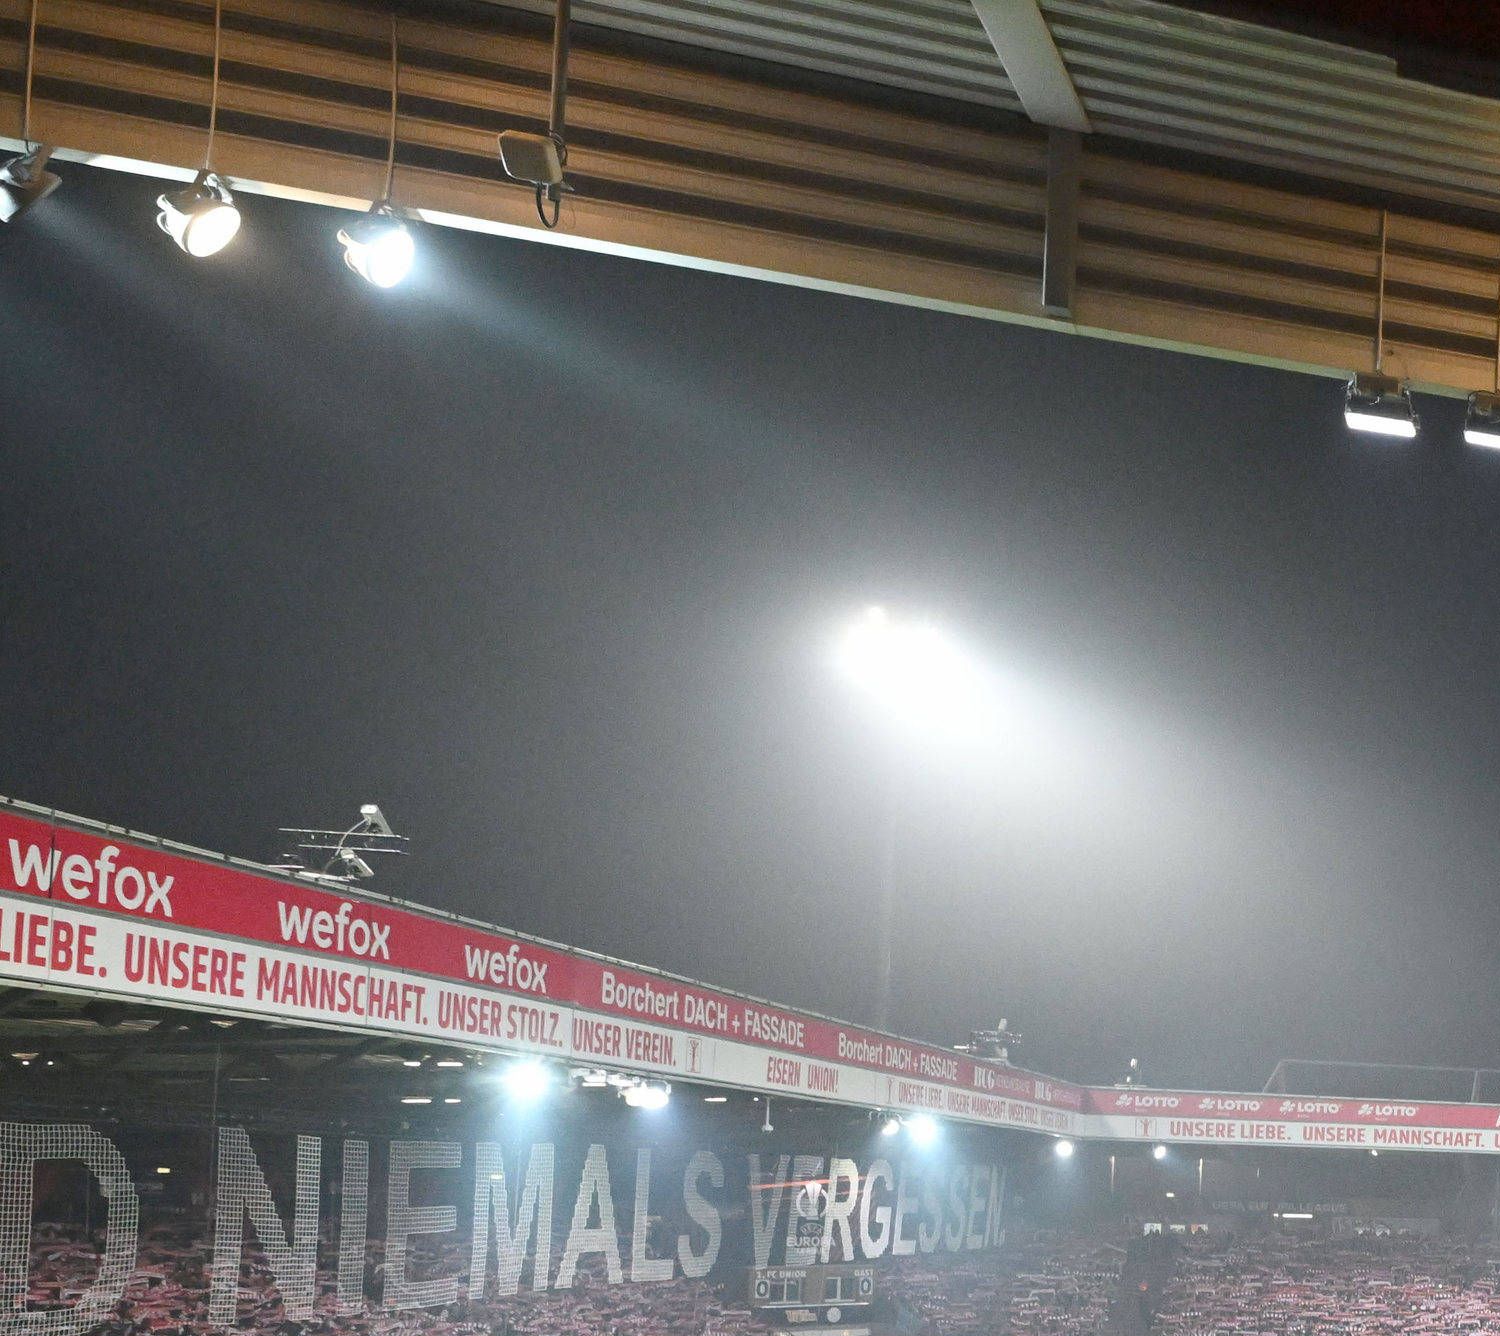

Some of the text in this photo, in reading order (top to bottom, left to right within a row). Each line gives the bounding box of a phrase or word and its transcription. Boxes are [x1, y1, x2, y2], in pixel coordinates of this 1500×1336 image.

[8, 838, 175, 917] wefox
[277, 901, 390, 961] wefox
[464, 943, 548, 994] wefox
[124, 932, 245, 998] UNSERE
[257, 957, 428, 1027] MANNSCHAFT.
[437, 990, 502, 1037] UNSER
[507, 1004, 563, 1049] STOLZ.
[572, 1017, 621, 1057] UNSER
[625, 1028, 677, 1067] VEREIN.
[602, 971, 679, 1021] Borchert
[684, 994, 728, 1032] DACH
[744, 1009, 805, 1049] FASSADE
[767, 1056, 839, 1093] EISERN UNION!
[838, 1032, 883, 1064] Borchert
[885, 1045, 912, 1072] DACH
[920, 1051, 959, 1081] FASSADE
[1135, 1095, 1180, 1108] LOTTO
[1217, 1099, 1261, 1111] LOTTO
[1297, 1102, 1340, 1114] LOTTO
[1375, 1104, 1416, 1117] LOTTO
[1170, 1121, 1236, 1139] UNSERE
[1240, 1124, 1291, 1141] LIEBE.
[1302, 1125, 1365, 1143] UNSERE
[1373, 1129, 1485, 1149] MANNSCHAFT.
[209, 1126, 725, 1326] NIEMALS
